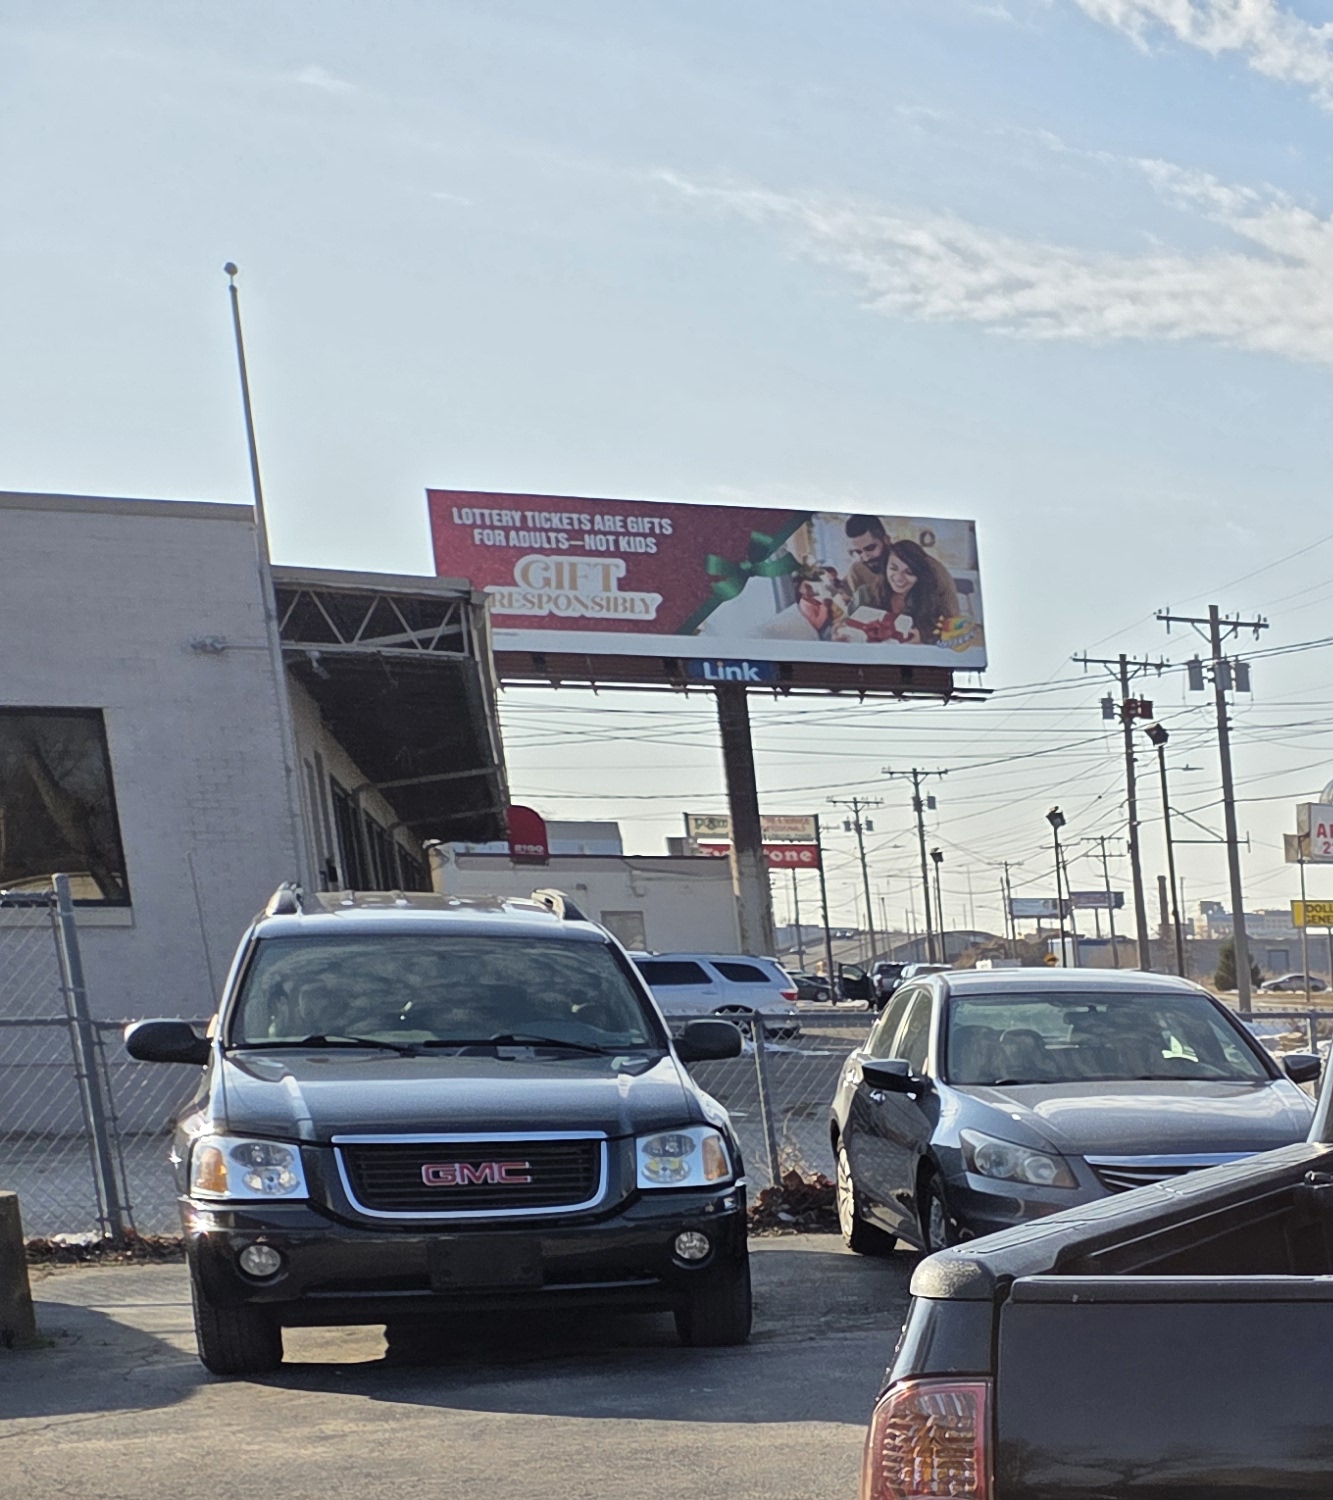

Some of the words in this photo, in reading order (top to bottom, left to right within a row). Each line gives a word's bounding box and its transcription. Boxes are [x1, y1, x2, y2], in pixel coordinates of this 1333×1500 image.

[452, 507, 521, 527] LOTTERY
[524, 511, 591, 530] TICKETS
[594, 514, 624, 532] ARE
[627, 517, 673, 535] GIFTS
[473, 528, 506, 547] FOR
[619, 536, 657, 553] KIDS
[521, 559, 620, 592] GIFT
[490, 591, 656, 615] RESPONSIBLY
[703, 661, 762, 682] Link
[422, 1162, 531, 1186] GMC
